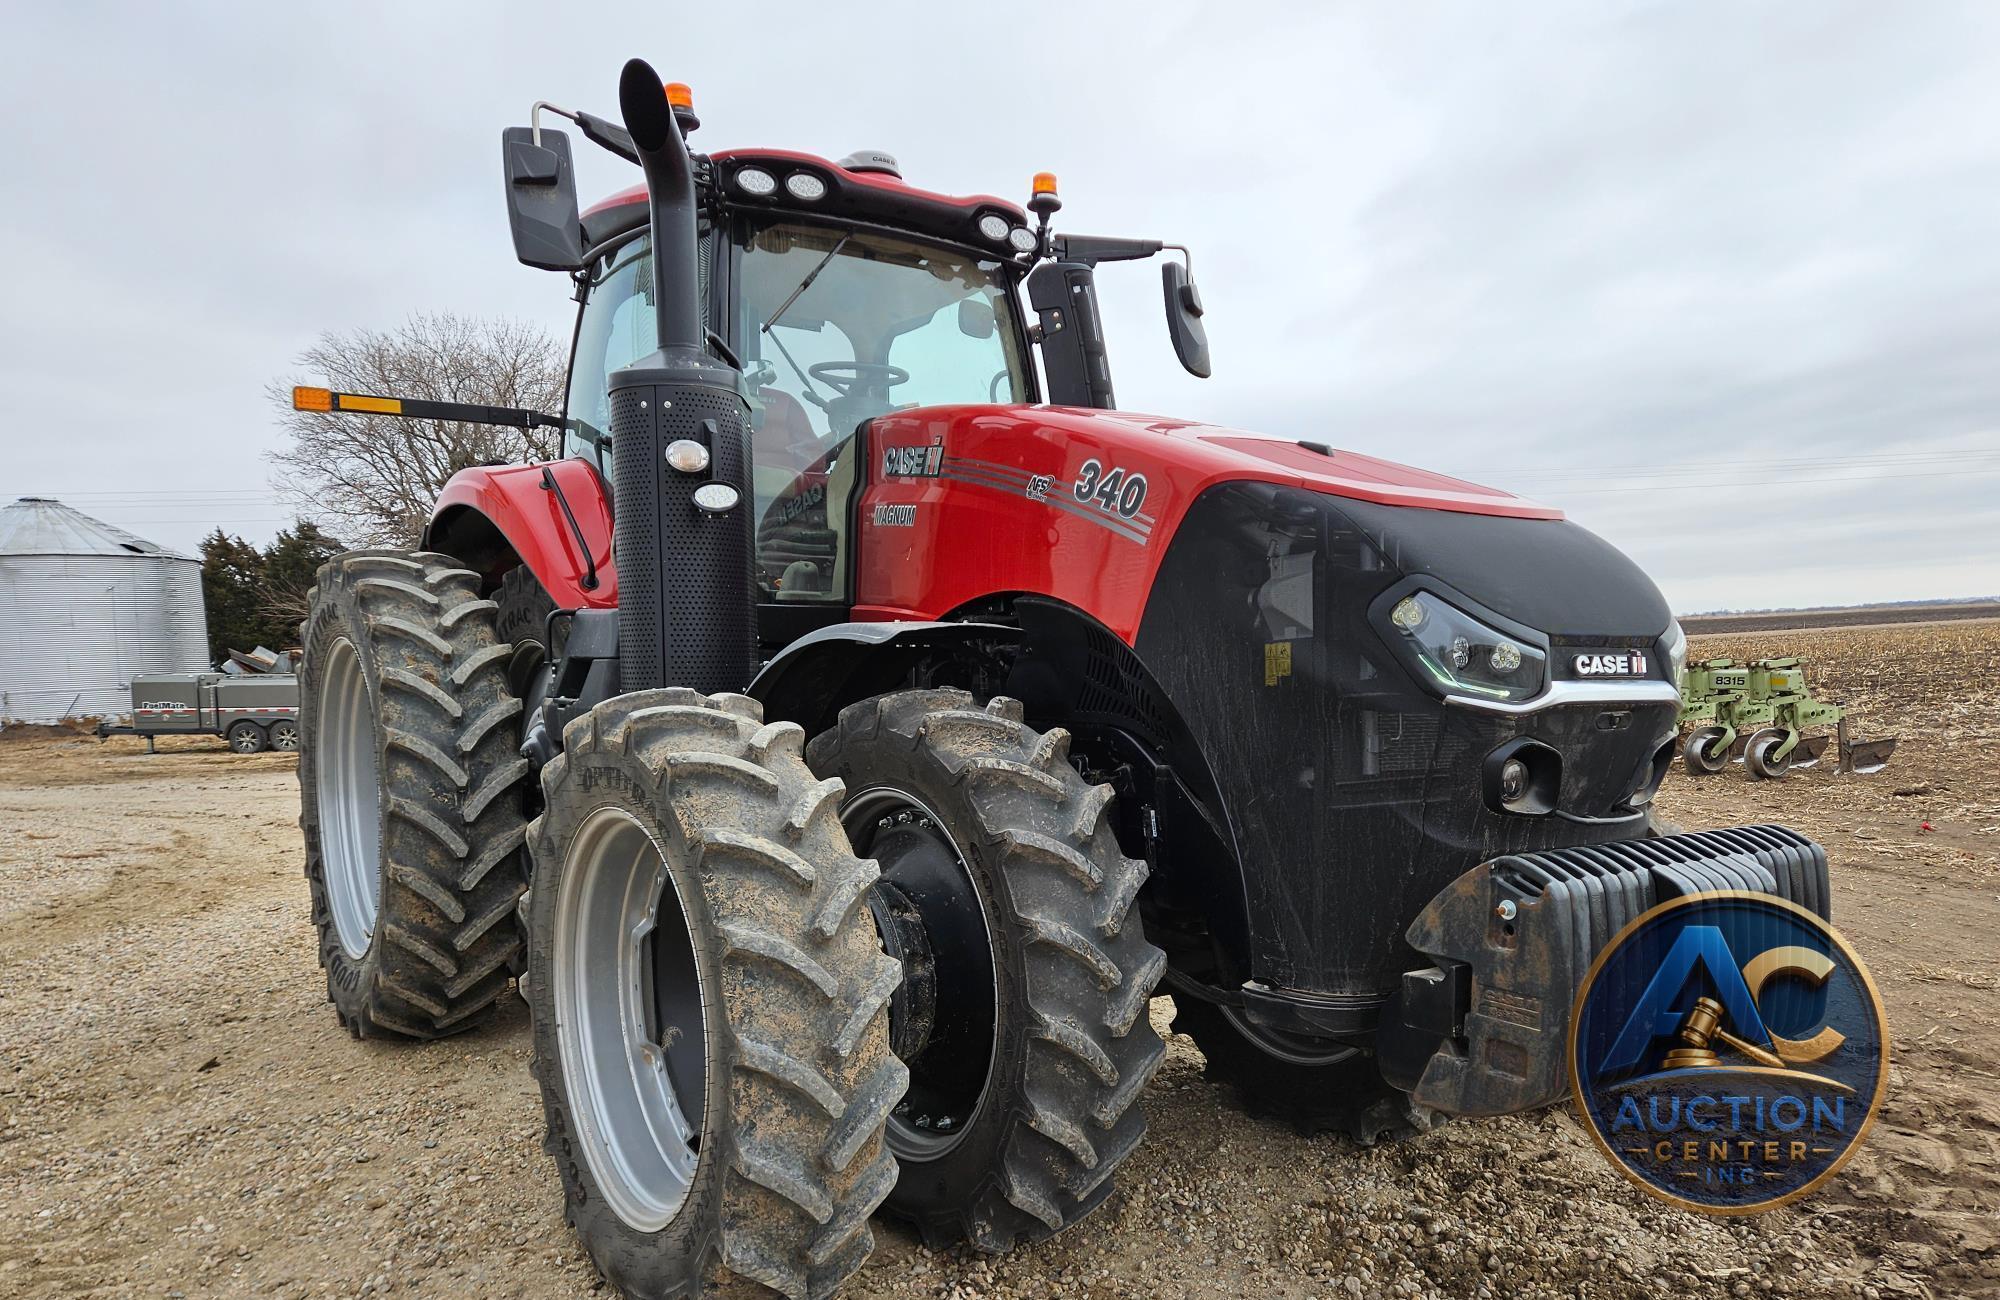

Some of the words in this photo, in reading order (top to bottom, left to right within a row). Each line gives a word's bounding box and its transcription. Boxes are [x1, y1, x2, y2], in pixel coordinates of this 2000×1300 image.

[884, 447, 925, 476] CASE
[1073, 458, 1148, 519] 340
[872, 504, 918, 527] MAGNUM
[1576, 655, 1629, 675] CASE
[1715, 676, 1746, 686] 8315
